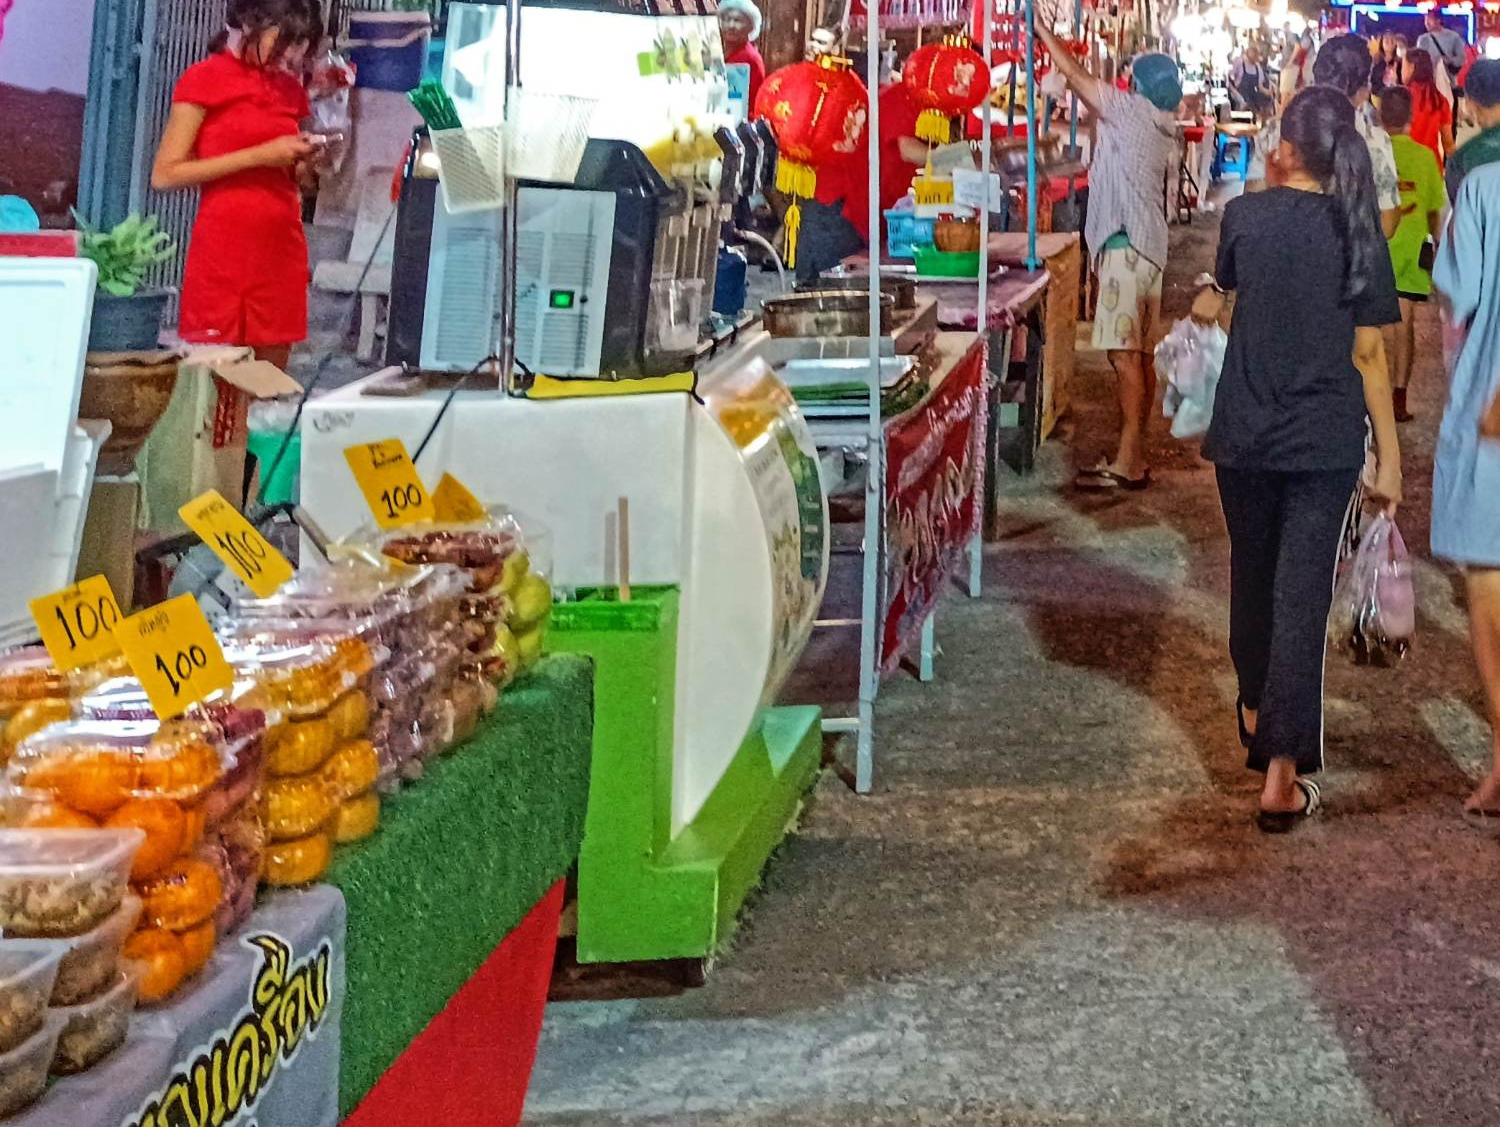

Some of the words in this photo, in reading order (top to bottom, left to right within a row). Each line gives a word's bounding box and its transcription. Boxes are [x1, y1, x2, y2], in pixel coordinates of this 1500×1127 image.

[381, 484, 422, 519] 100
[214, 529, 267, 580] 100
[55, 597, 118, 650] 100
[155, 644, 207, 697] 100
